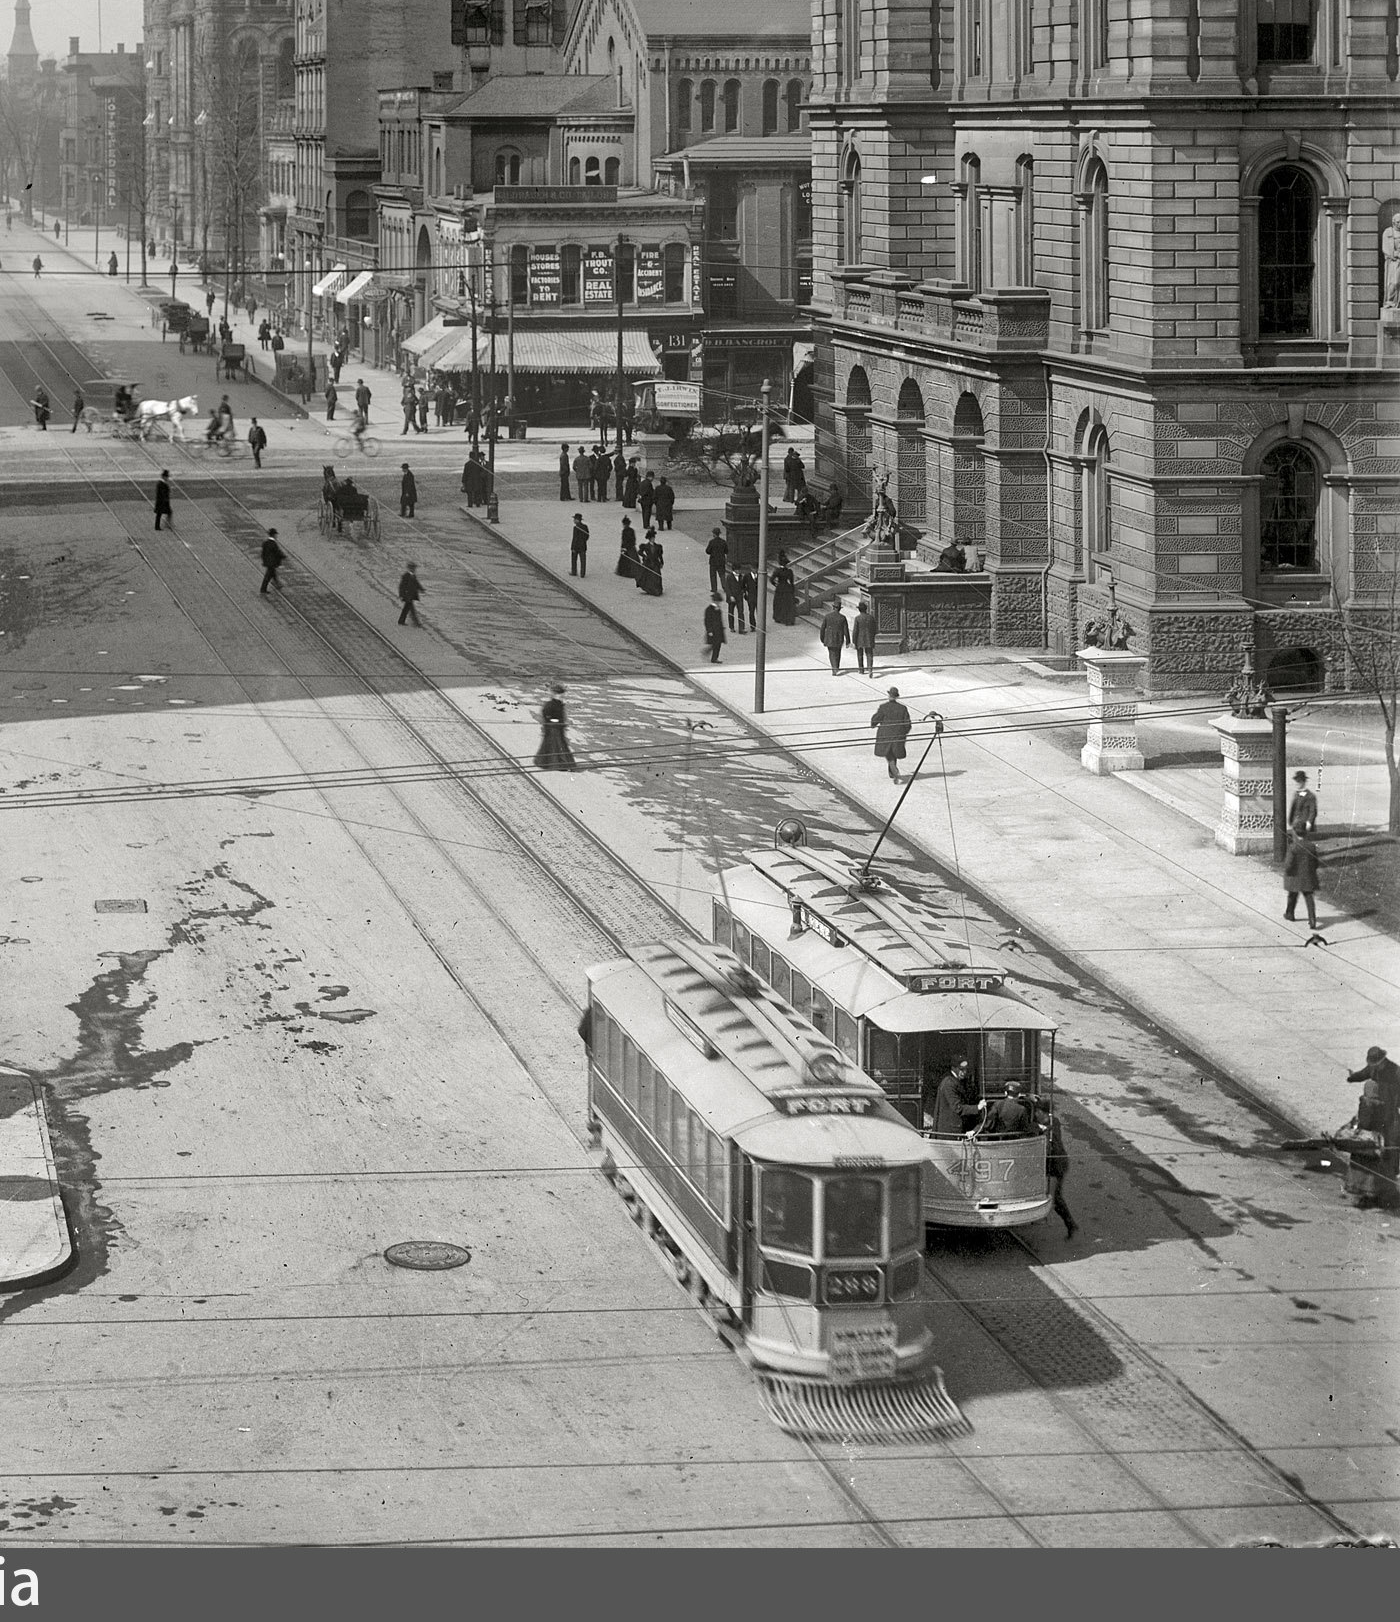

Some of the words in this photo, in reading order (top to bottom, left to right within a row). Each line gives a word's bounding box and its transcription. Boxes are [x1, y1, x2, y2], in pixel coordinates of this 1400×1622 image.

[641, 251, 660, 259] FIRE
[530, 262, 560, 270] STORES
[585, 259, 613, 267] TROUT
[539, 285, 551, 293] TO
[585, 281, 612, 290] REAL
[532, 292, 559, 301] RENT
[584, 290, 613, 299] ESTATE
[669, 335, 685, 346] 131
[920, 976, 994, 990] FORT
[786, 1096, 871, 1114] FORT
[946, 1159, 1015, 1183] 497
